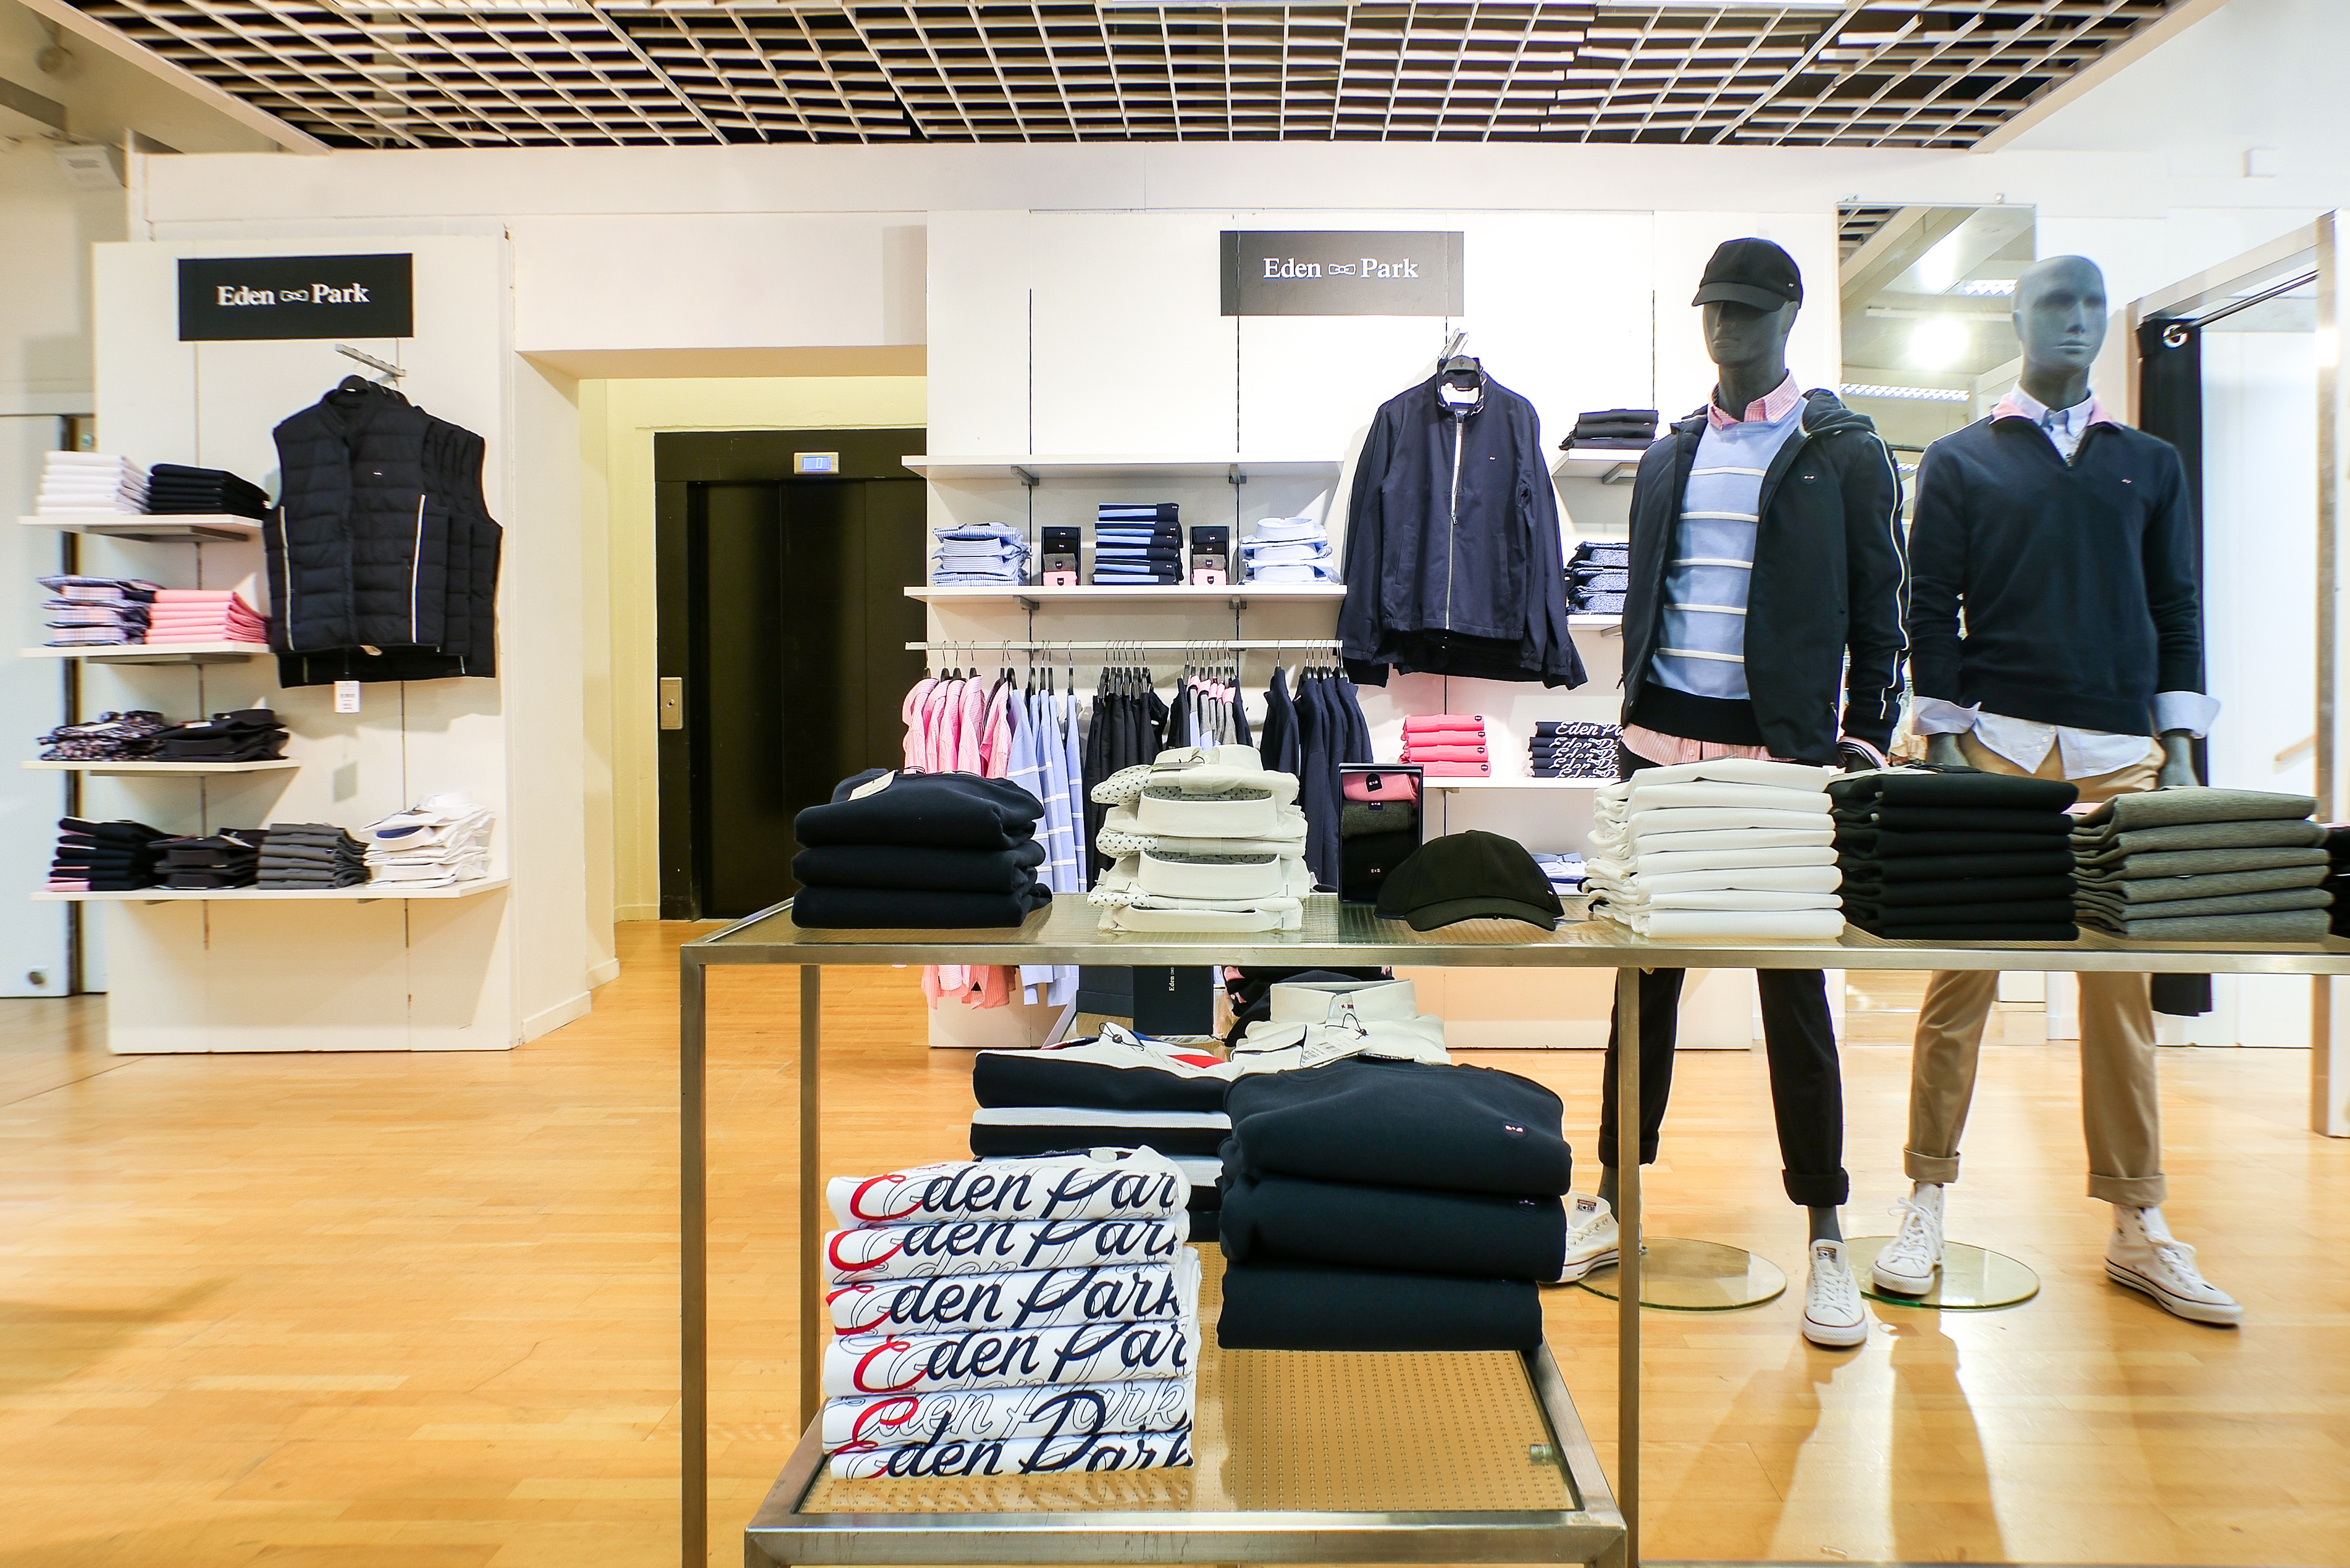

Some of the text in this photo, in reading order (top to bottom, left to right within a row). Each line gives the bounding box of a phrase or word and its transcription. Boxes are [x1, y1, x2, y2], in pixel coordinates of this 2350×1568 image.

[1263, 257, 1419, 279] Eden Park
[216, 282, 370, 306] Eden Park
[1555, 721, 1598, 736] Eden
